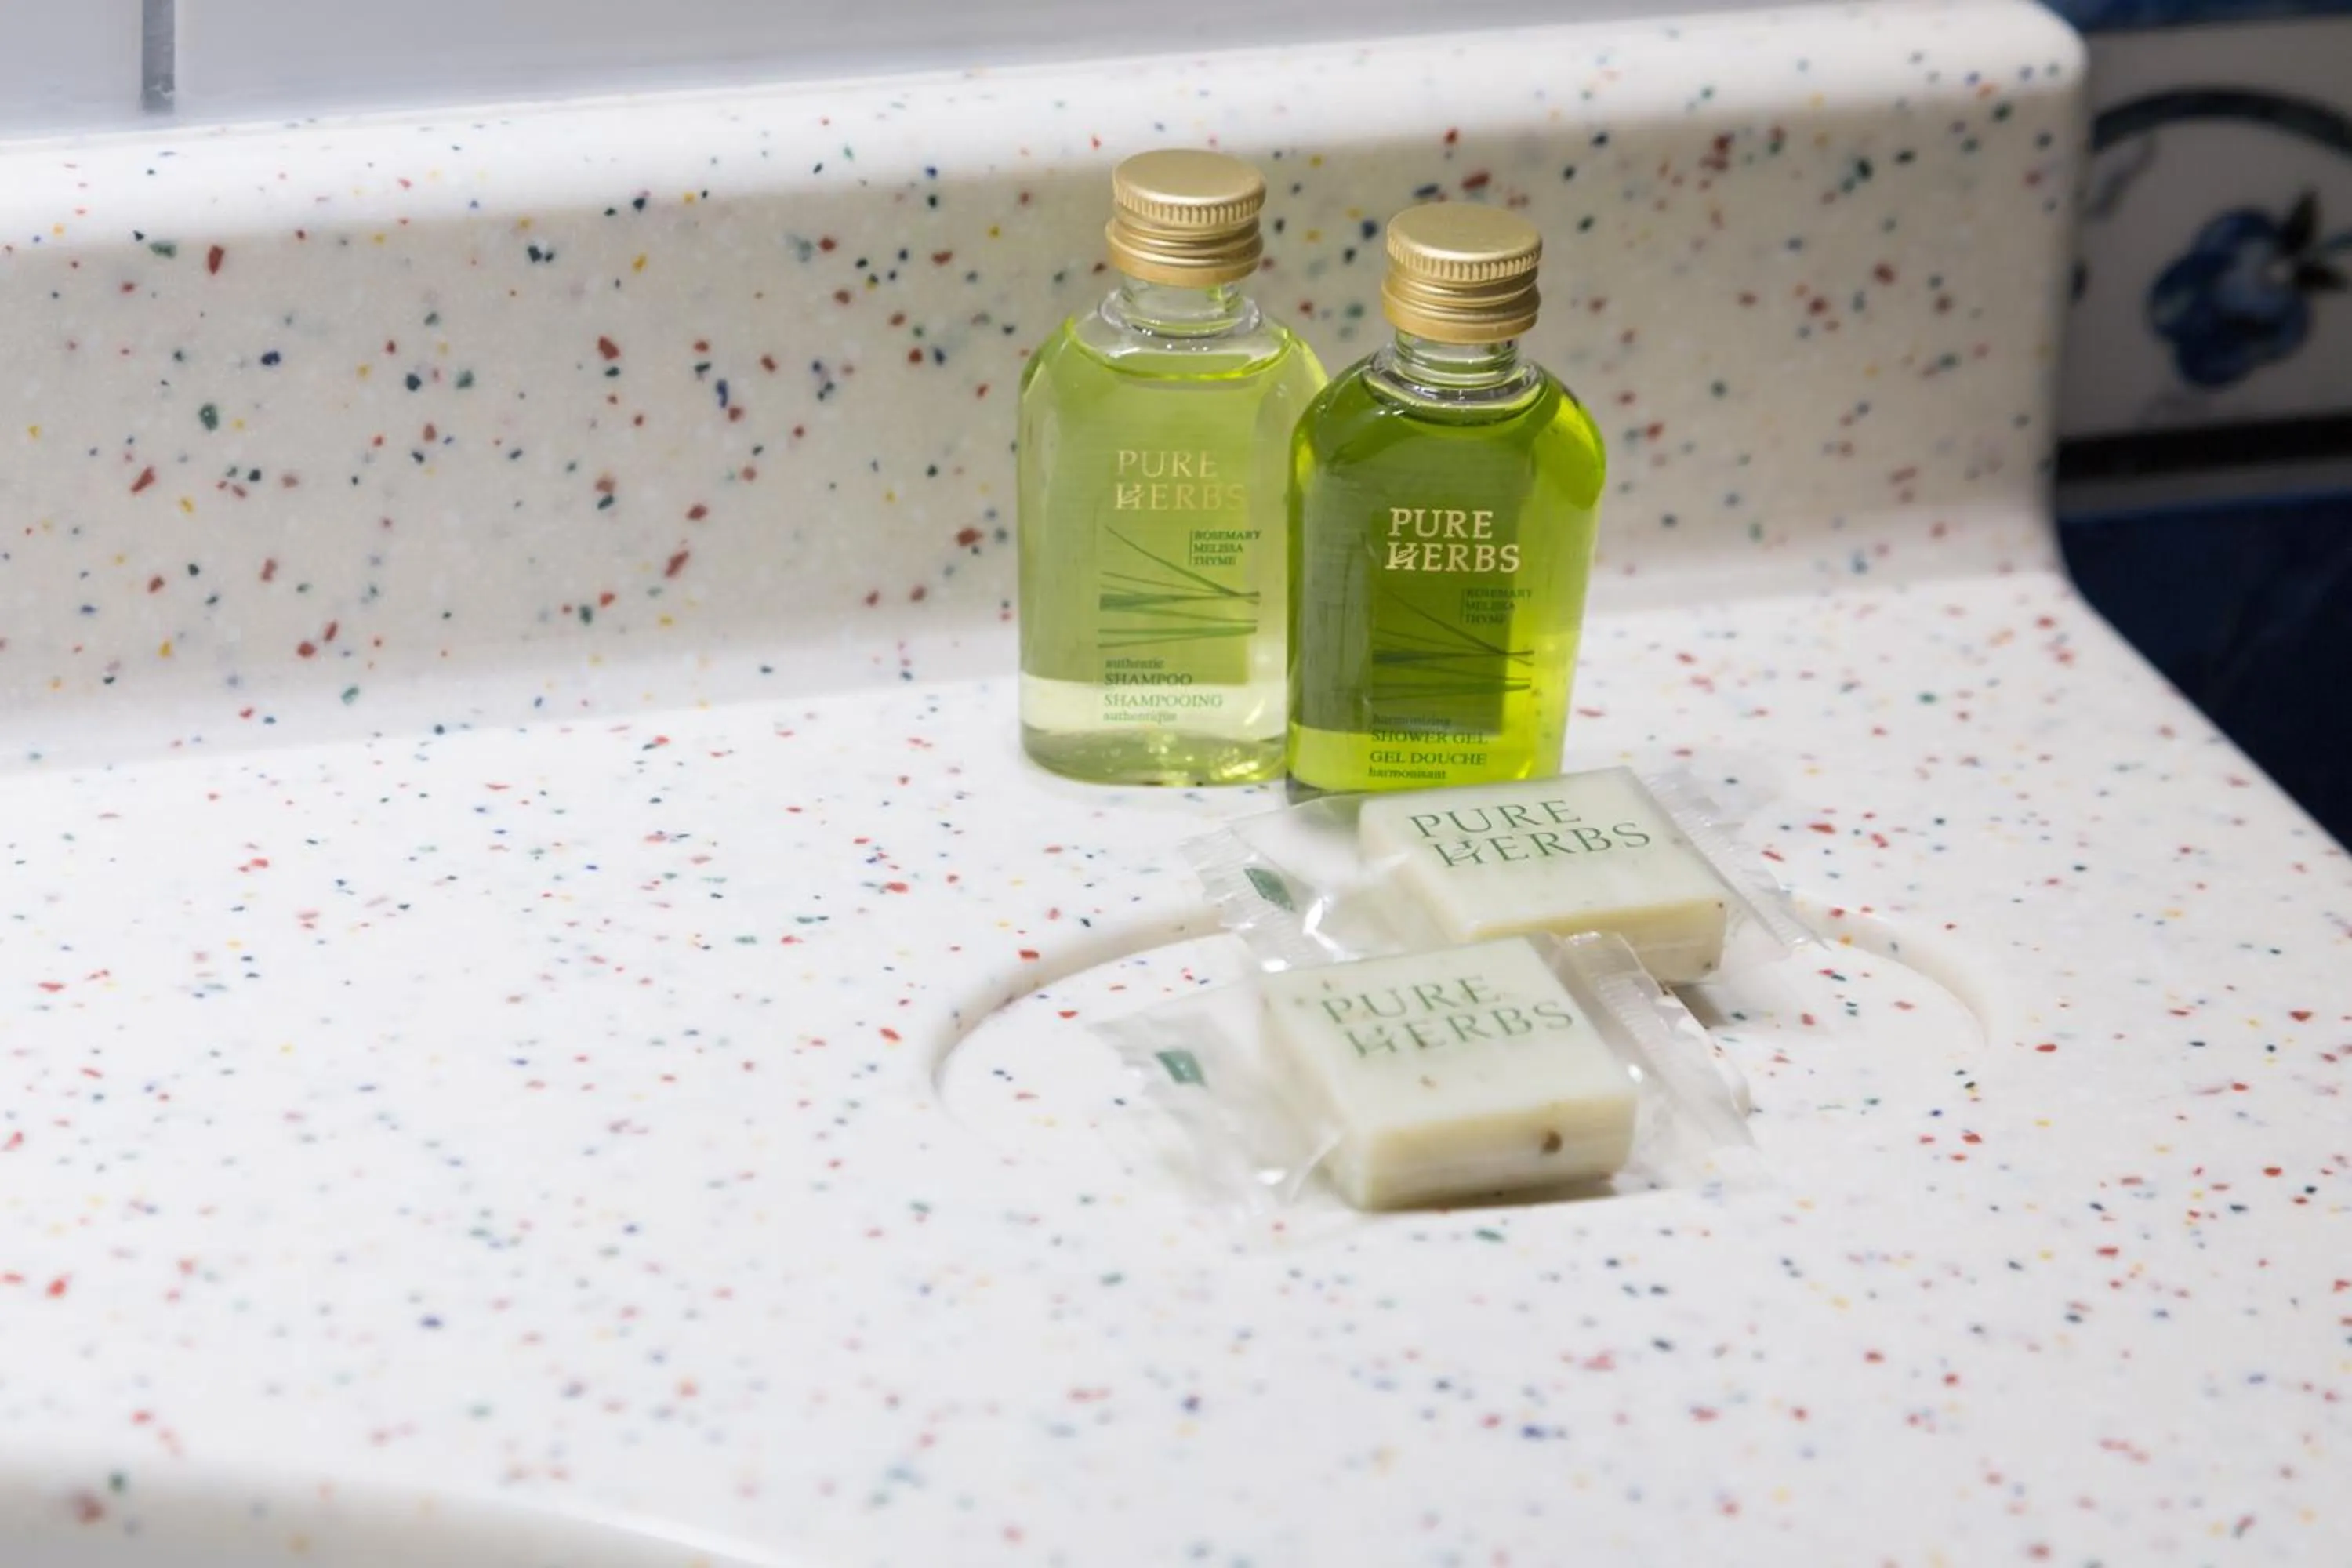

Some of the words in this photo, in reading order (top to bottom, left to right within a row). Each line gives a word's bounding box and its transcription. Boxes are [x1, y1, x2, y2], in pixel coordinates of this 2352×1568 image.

[1116, 450, 1218, 478] PURE
[1115, 482, 1247, 510] HERBS
[1193, 529, 1261, 541] ROSEMARY
[1387, 507, 1494, 539] PURE
[1192, 555, 1236, 566] THYME
[1385, 541, 1521, 574] HERBS
[1105, 658, 1165, 669] authentic
[1104, 673, 1193, 686] SHAMPOO
[1104, 693, 1224, 708] SHAMPOOING
[1372, 730, 1447, 743] SHOWER
[1452, 731, 1488, 745] GEL
[1370, 750, 1406, 764] GEL
[1410, 752, 1487, 766] DOUCHE
[1407, 800, 1581, 838] PURE
[1432, 822, 1650, 868] HERBS
[1321, 975, 1501, 1024] PURE
[1345, 1000, 1573, 1058] HERBS
